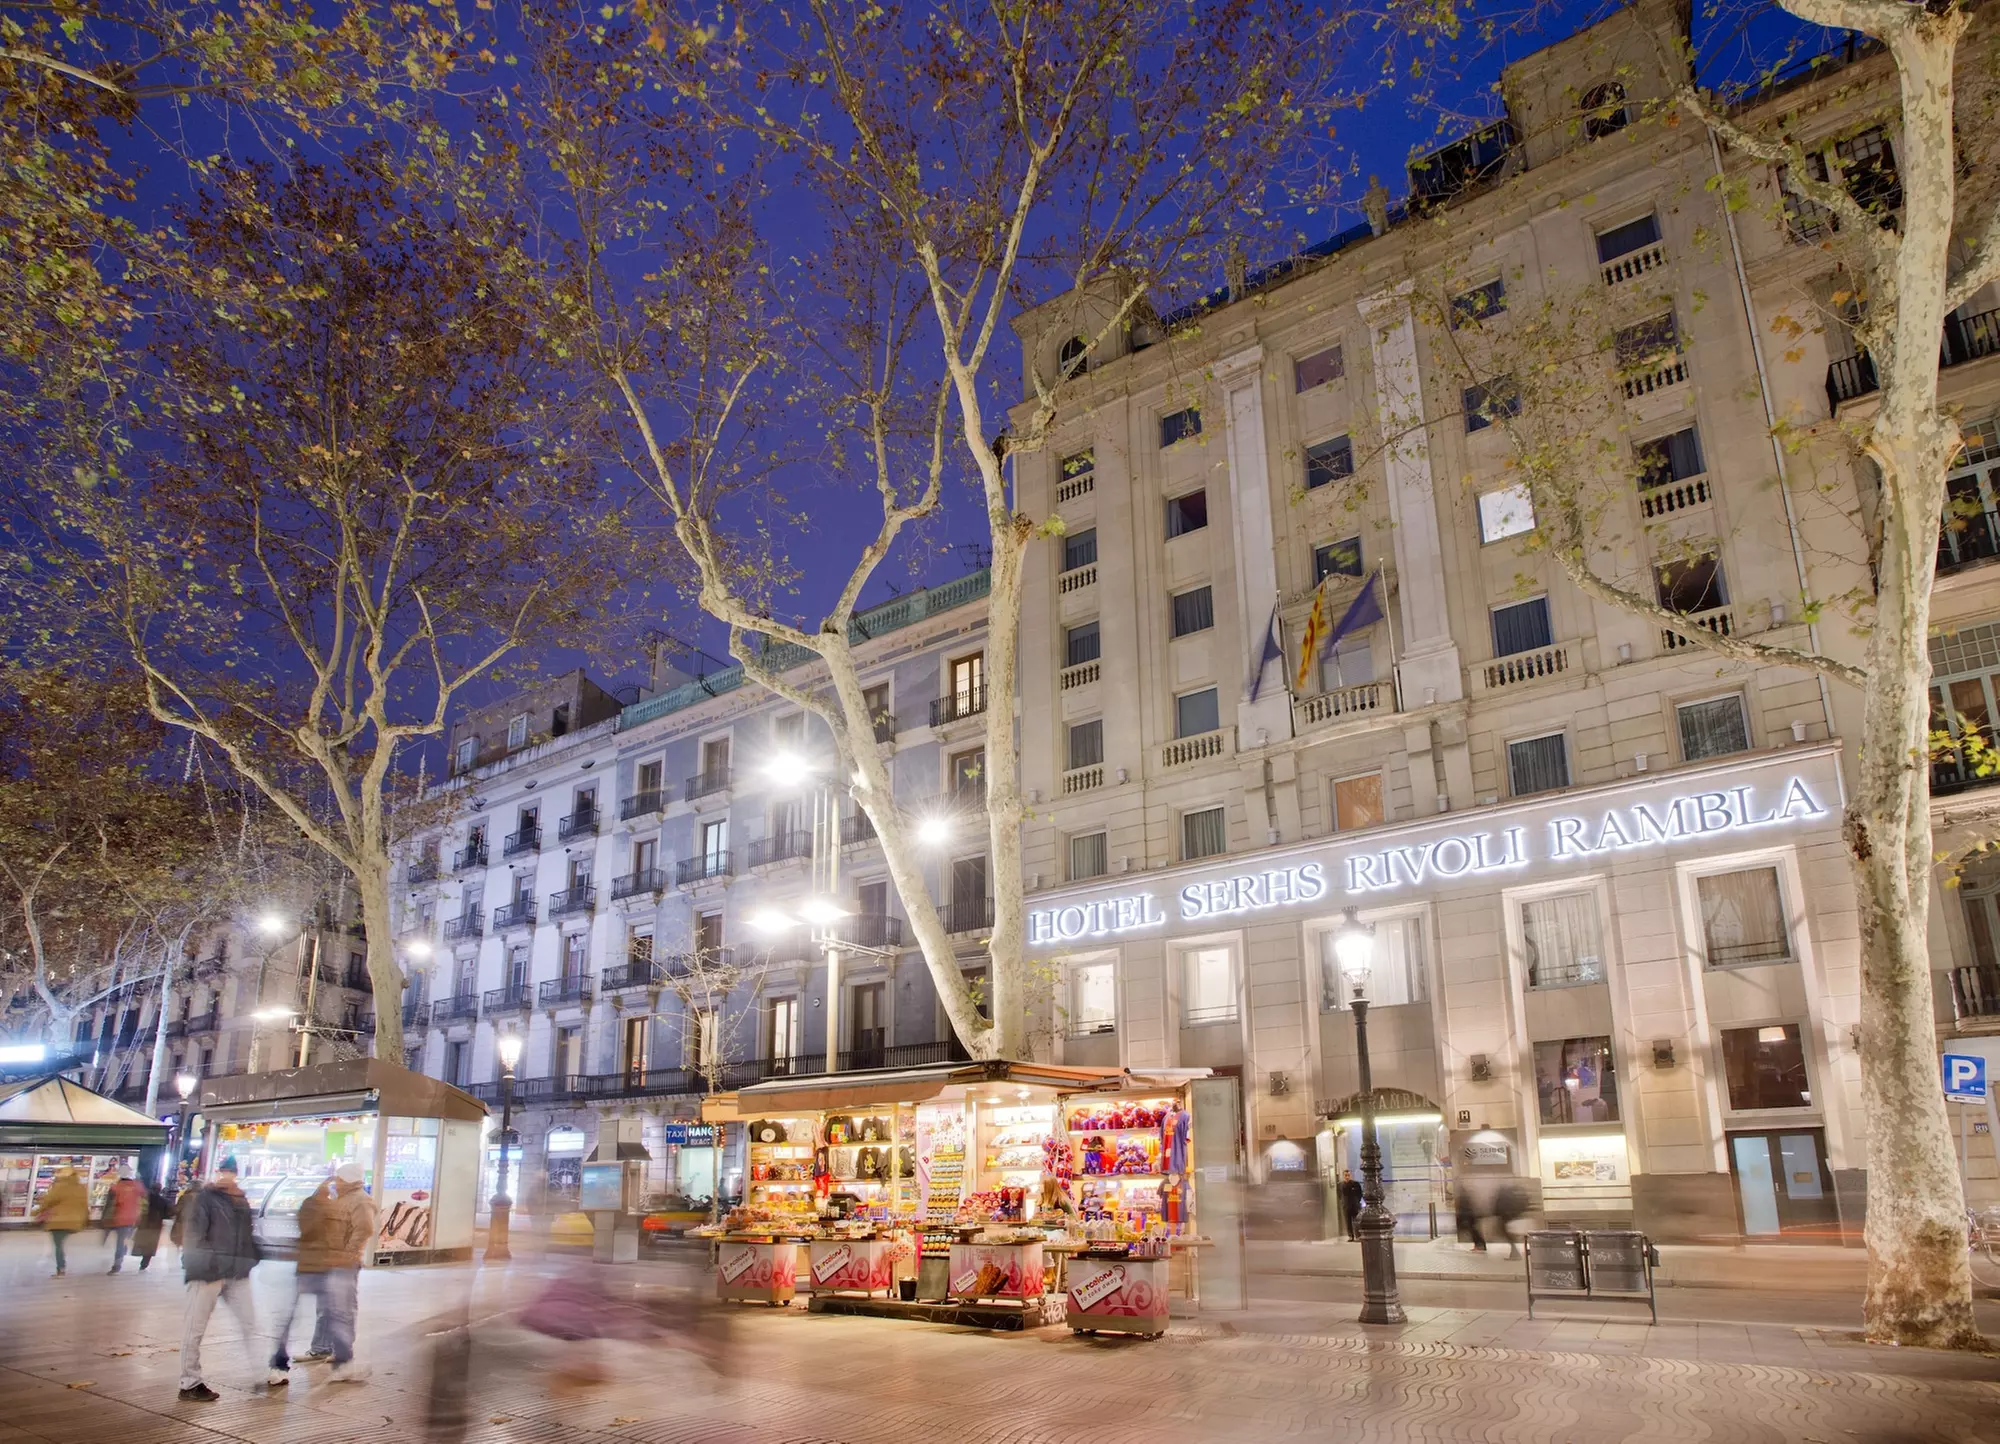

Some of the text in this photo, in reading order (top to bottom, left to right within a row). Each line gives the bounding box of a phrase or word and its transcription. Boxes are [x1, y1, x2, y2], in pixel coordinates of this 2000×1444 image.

[1029, 777, 1825, 944] HOTEL SERHS RIVOLI RAMBLA
[1951, 1059, 1977, 1090] P
[667, 1130, 686, 1138] TAXI
[688, 1127, 720, 1137] HANGE
